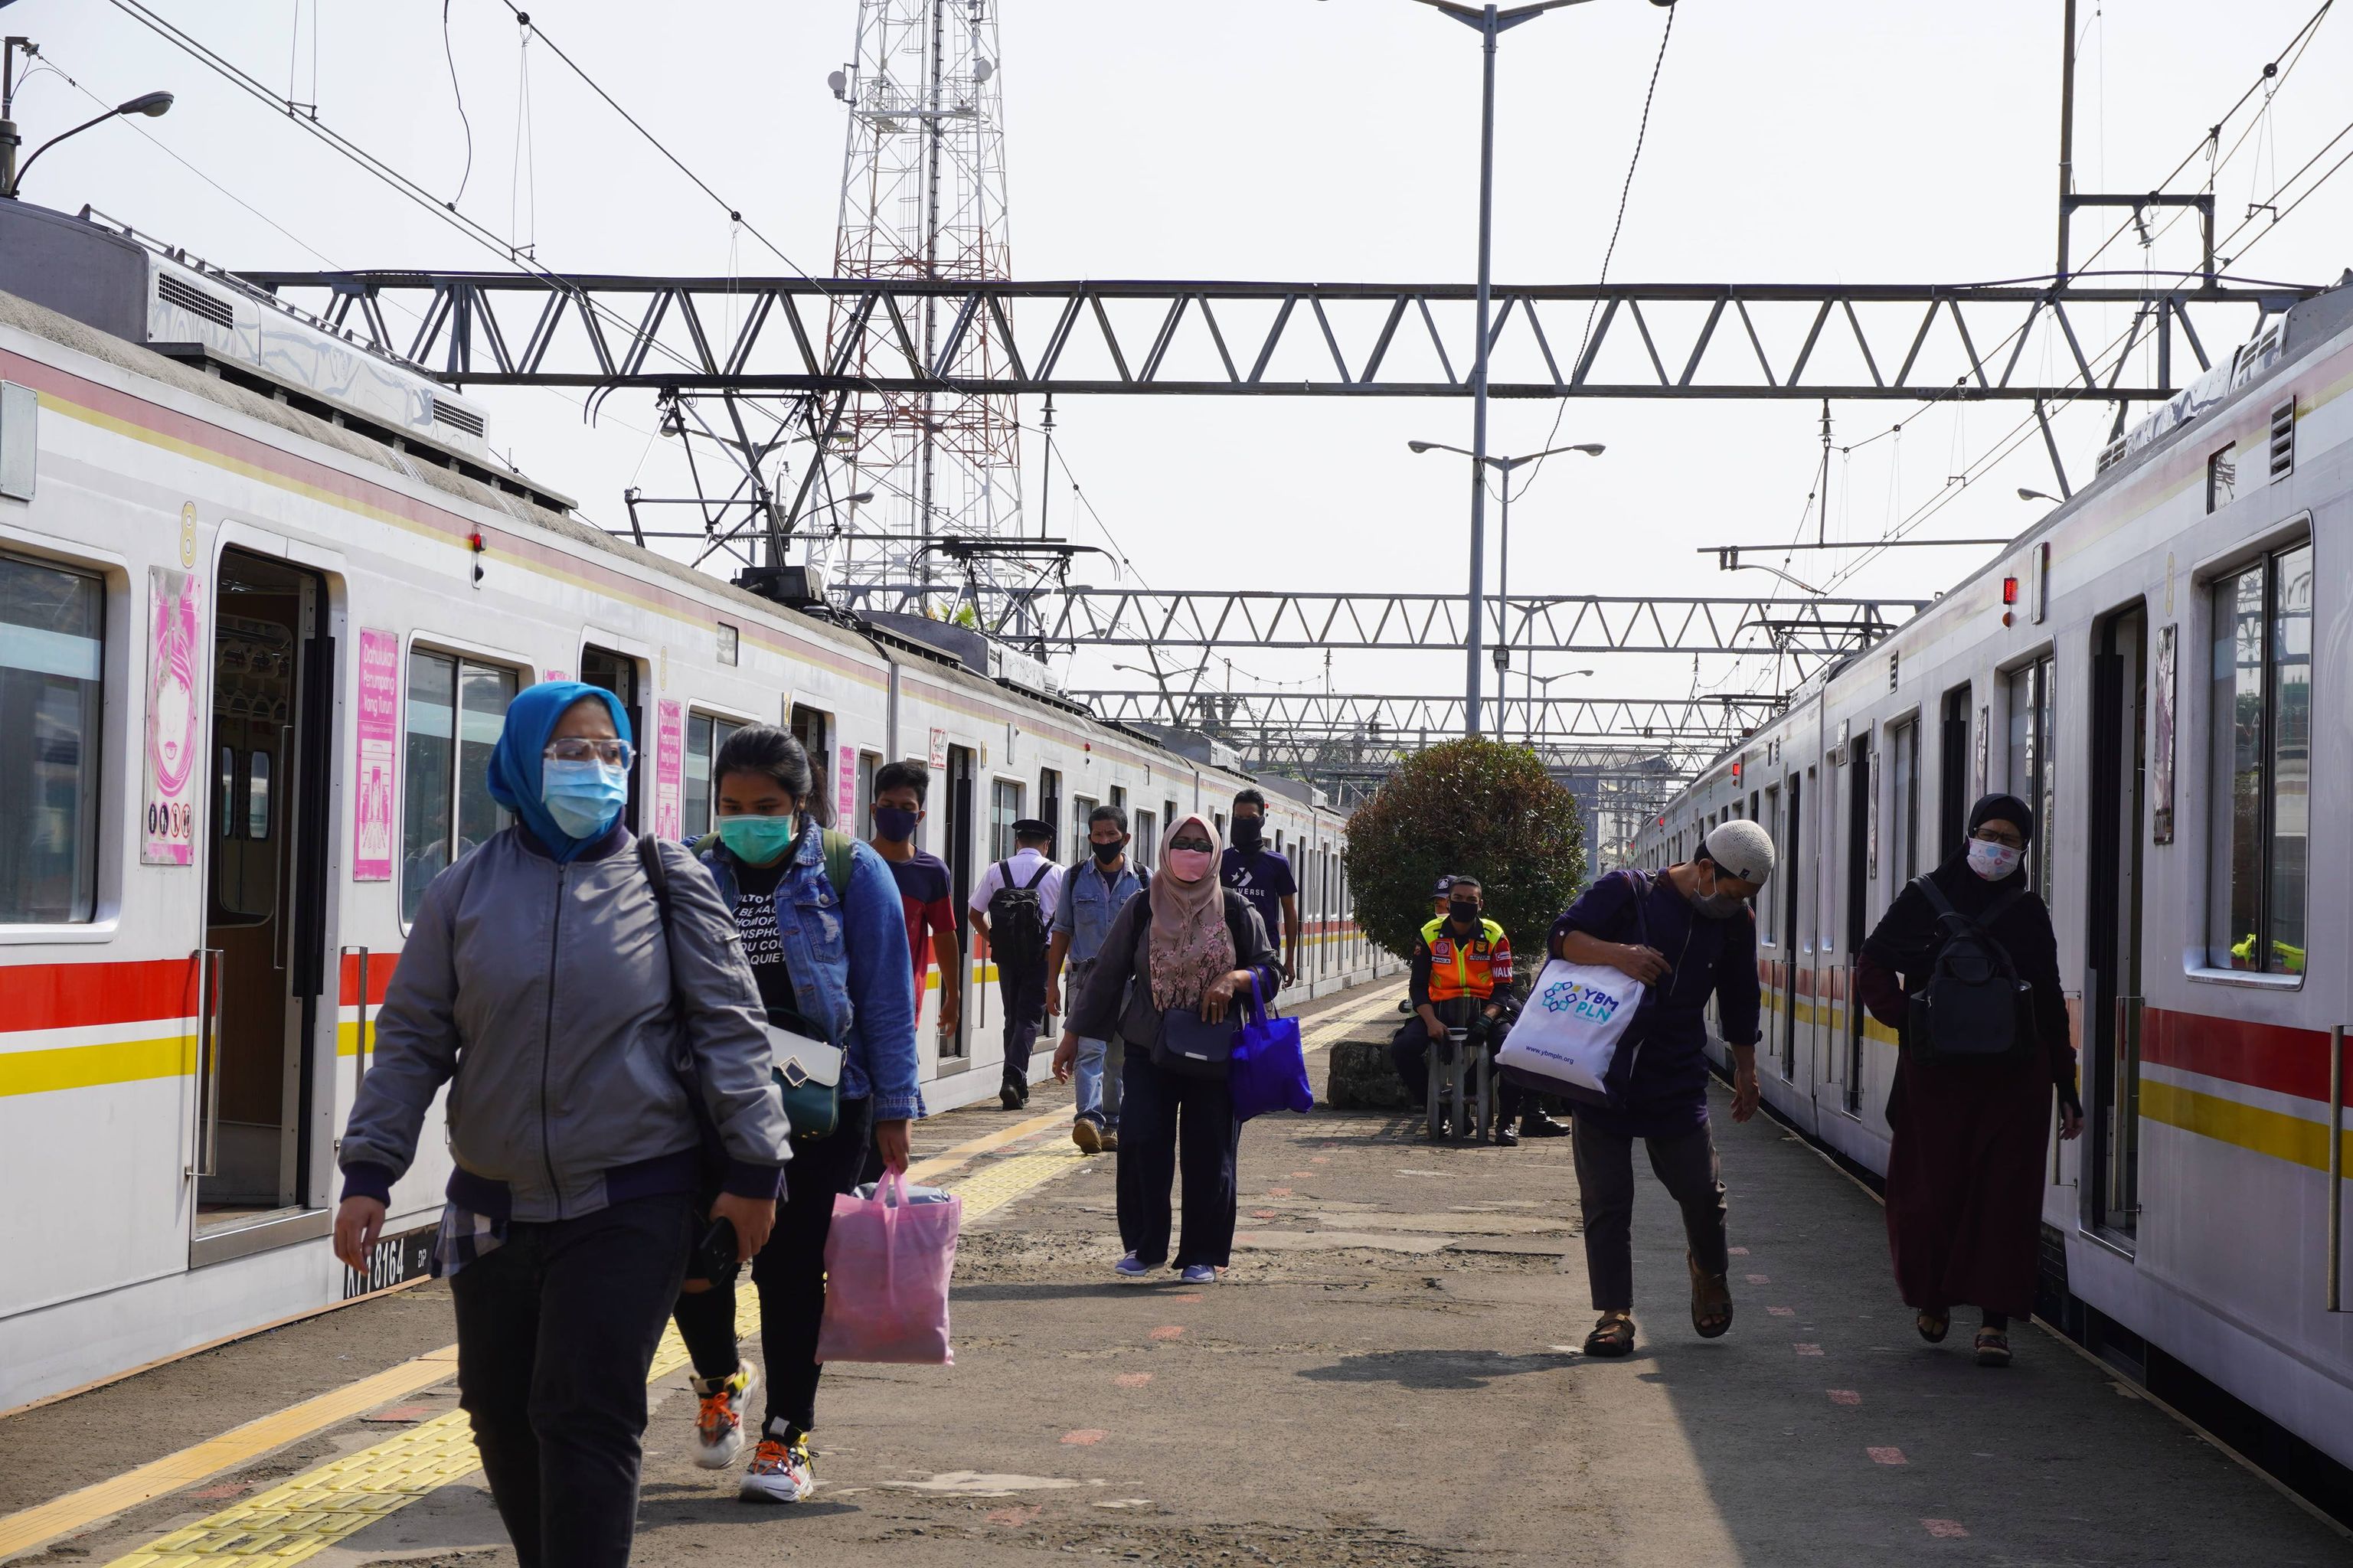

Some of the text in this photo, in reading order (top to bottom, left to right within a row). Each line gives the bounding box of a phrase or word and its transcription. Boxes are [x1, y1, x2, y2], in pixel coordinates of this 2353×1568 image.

[180, 501, 197, 568] 8
[1232, 888, 1265, 897] NVERSE
[735, 916, 777, 927] HOMOP
[740, 927, 779, 939] NSPHO
[741, 939, 783, 952] OU COU
[1584, 988, 1619, 1011] YBM
[1576, 1001, 1611, 1021] PLN
[1525, 1046, 1574, 1065] www.ybmpln.org
